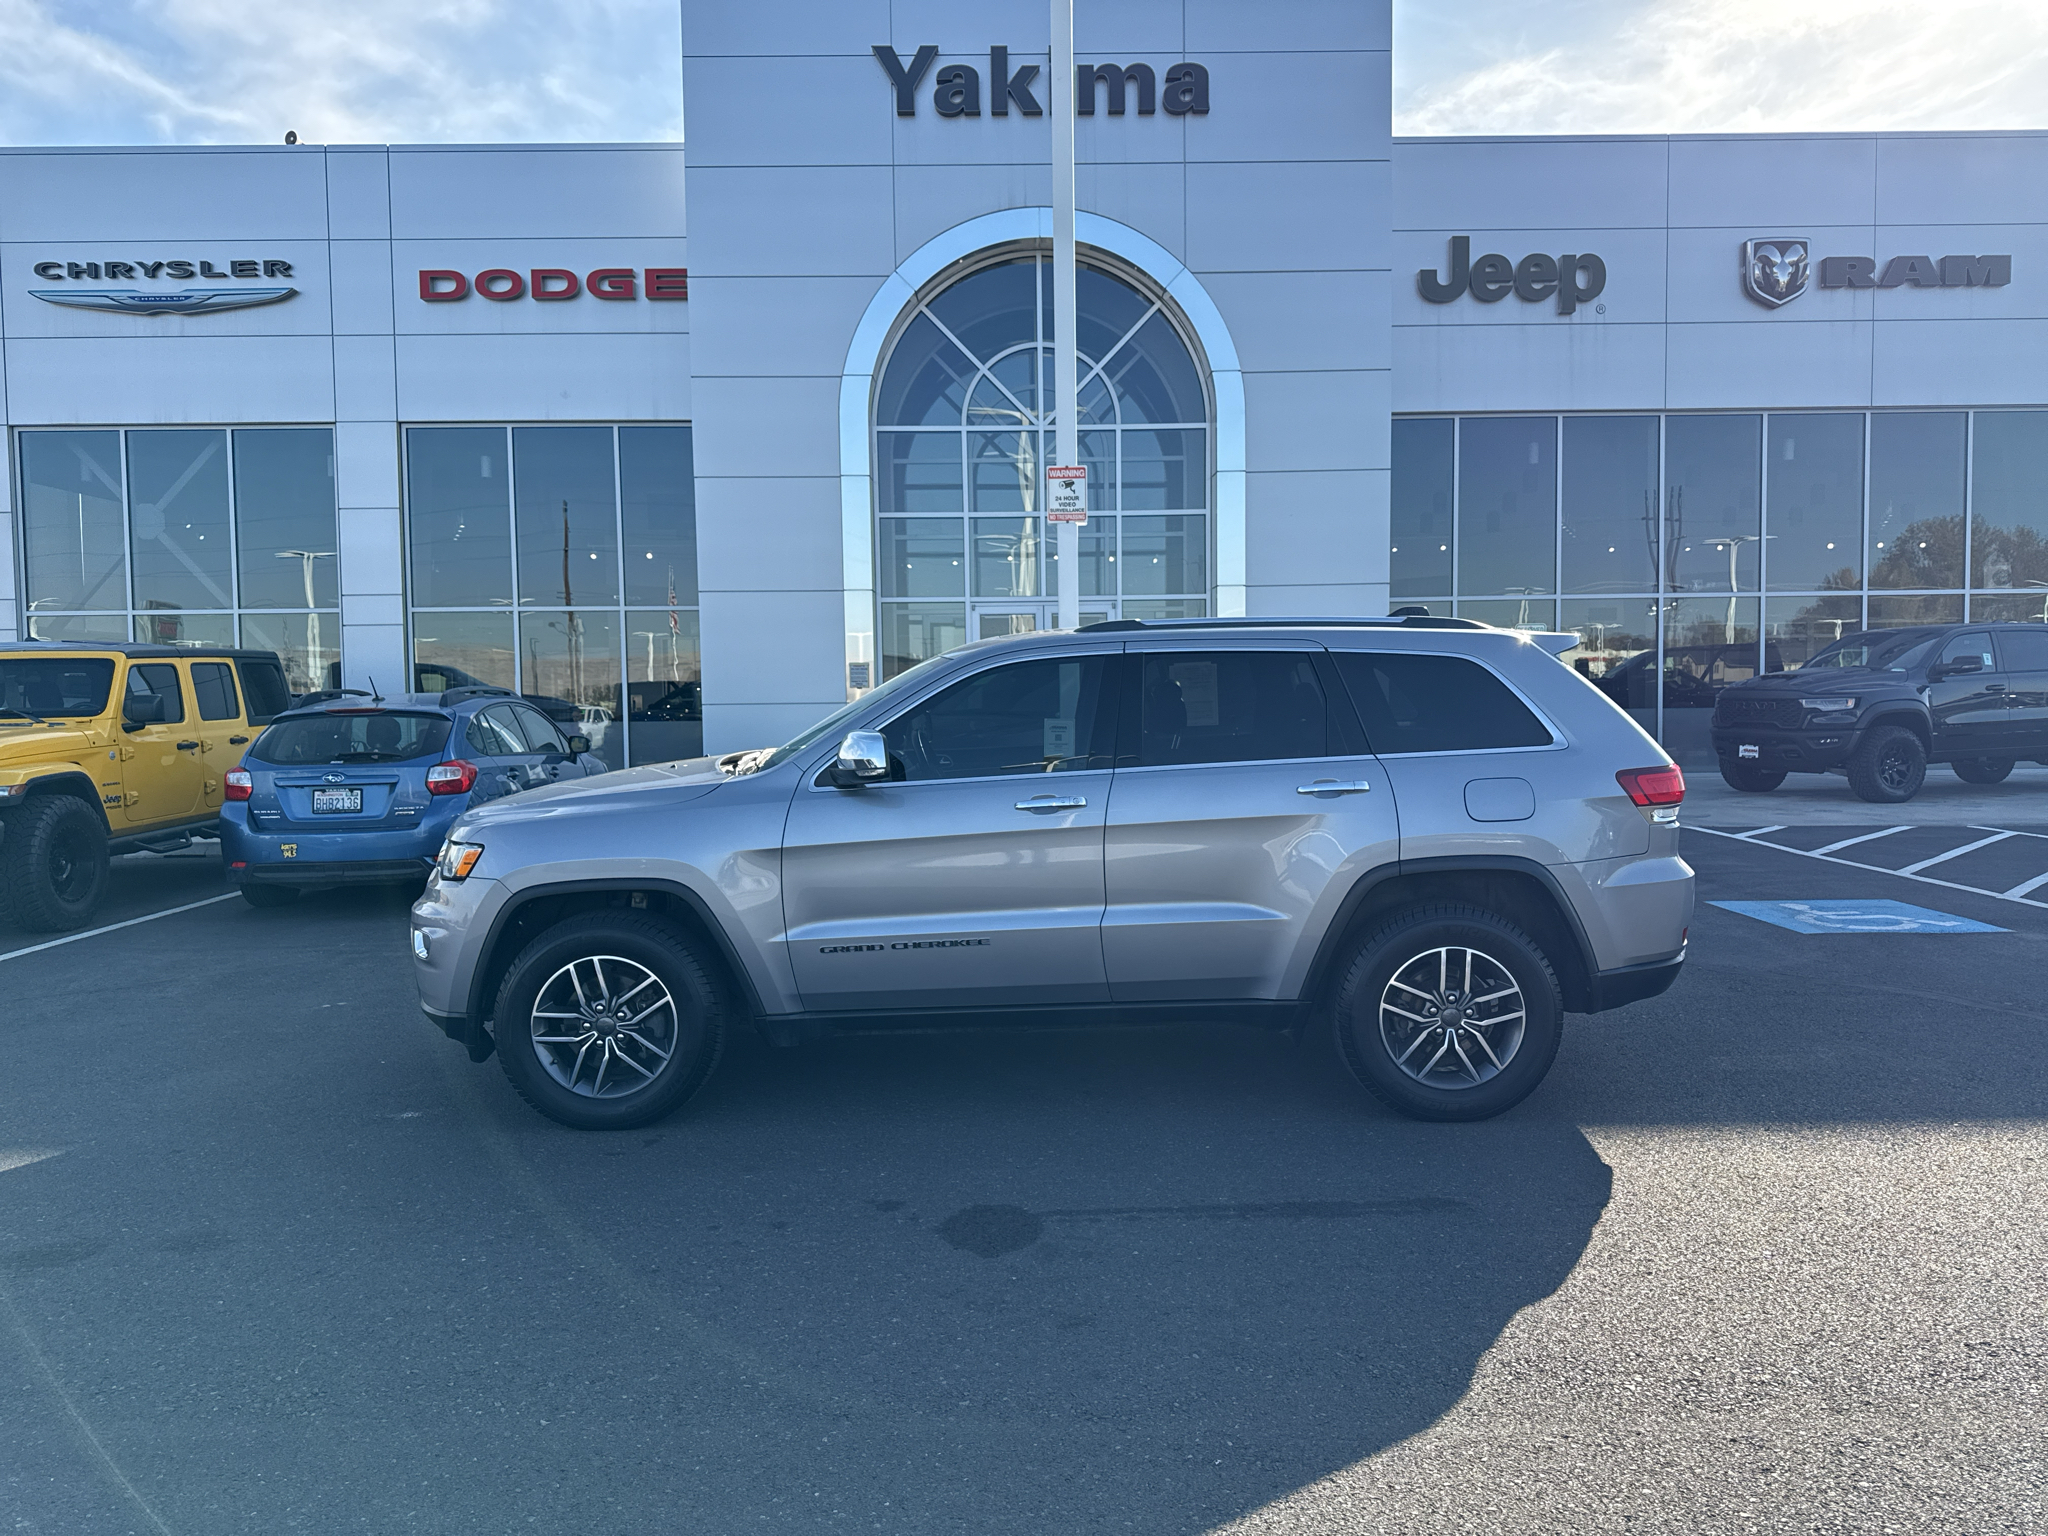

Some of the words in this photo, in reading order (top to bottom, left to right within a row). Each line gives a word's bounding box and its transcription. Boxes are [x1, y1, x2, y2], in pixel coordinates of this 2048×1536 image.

[871, 45, 1210, 116] Yakma
[33, 259, 294, 280] CHRYSLER
[1417, 236, 1607, 315] Jeep
[1821, 255, 2012, 288] RAM
[419, 268, 688, 303] DODGE
[1049, 469, 1084, 478] WARNING
[103, 794, 121, 804] Jeep
[820, 943, 884, 954] GRAND
[891, 938, 990, 950] CHEROKEE
